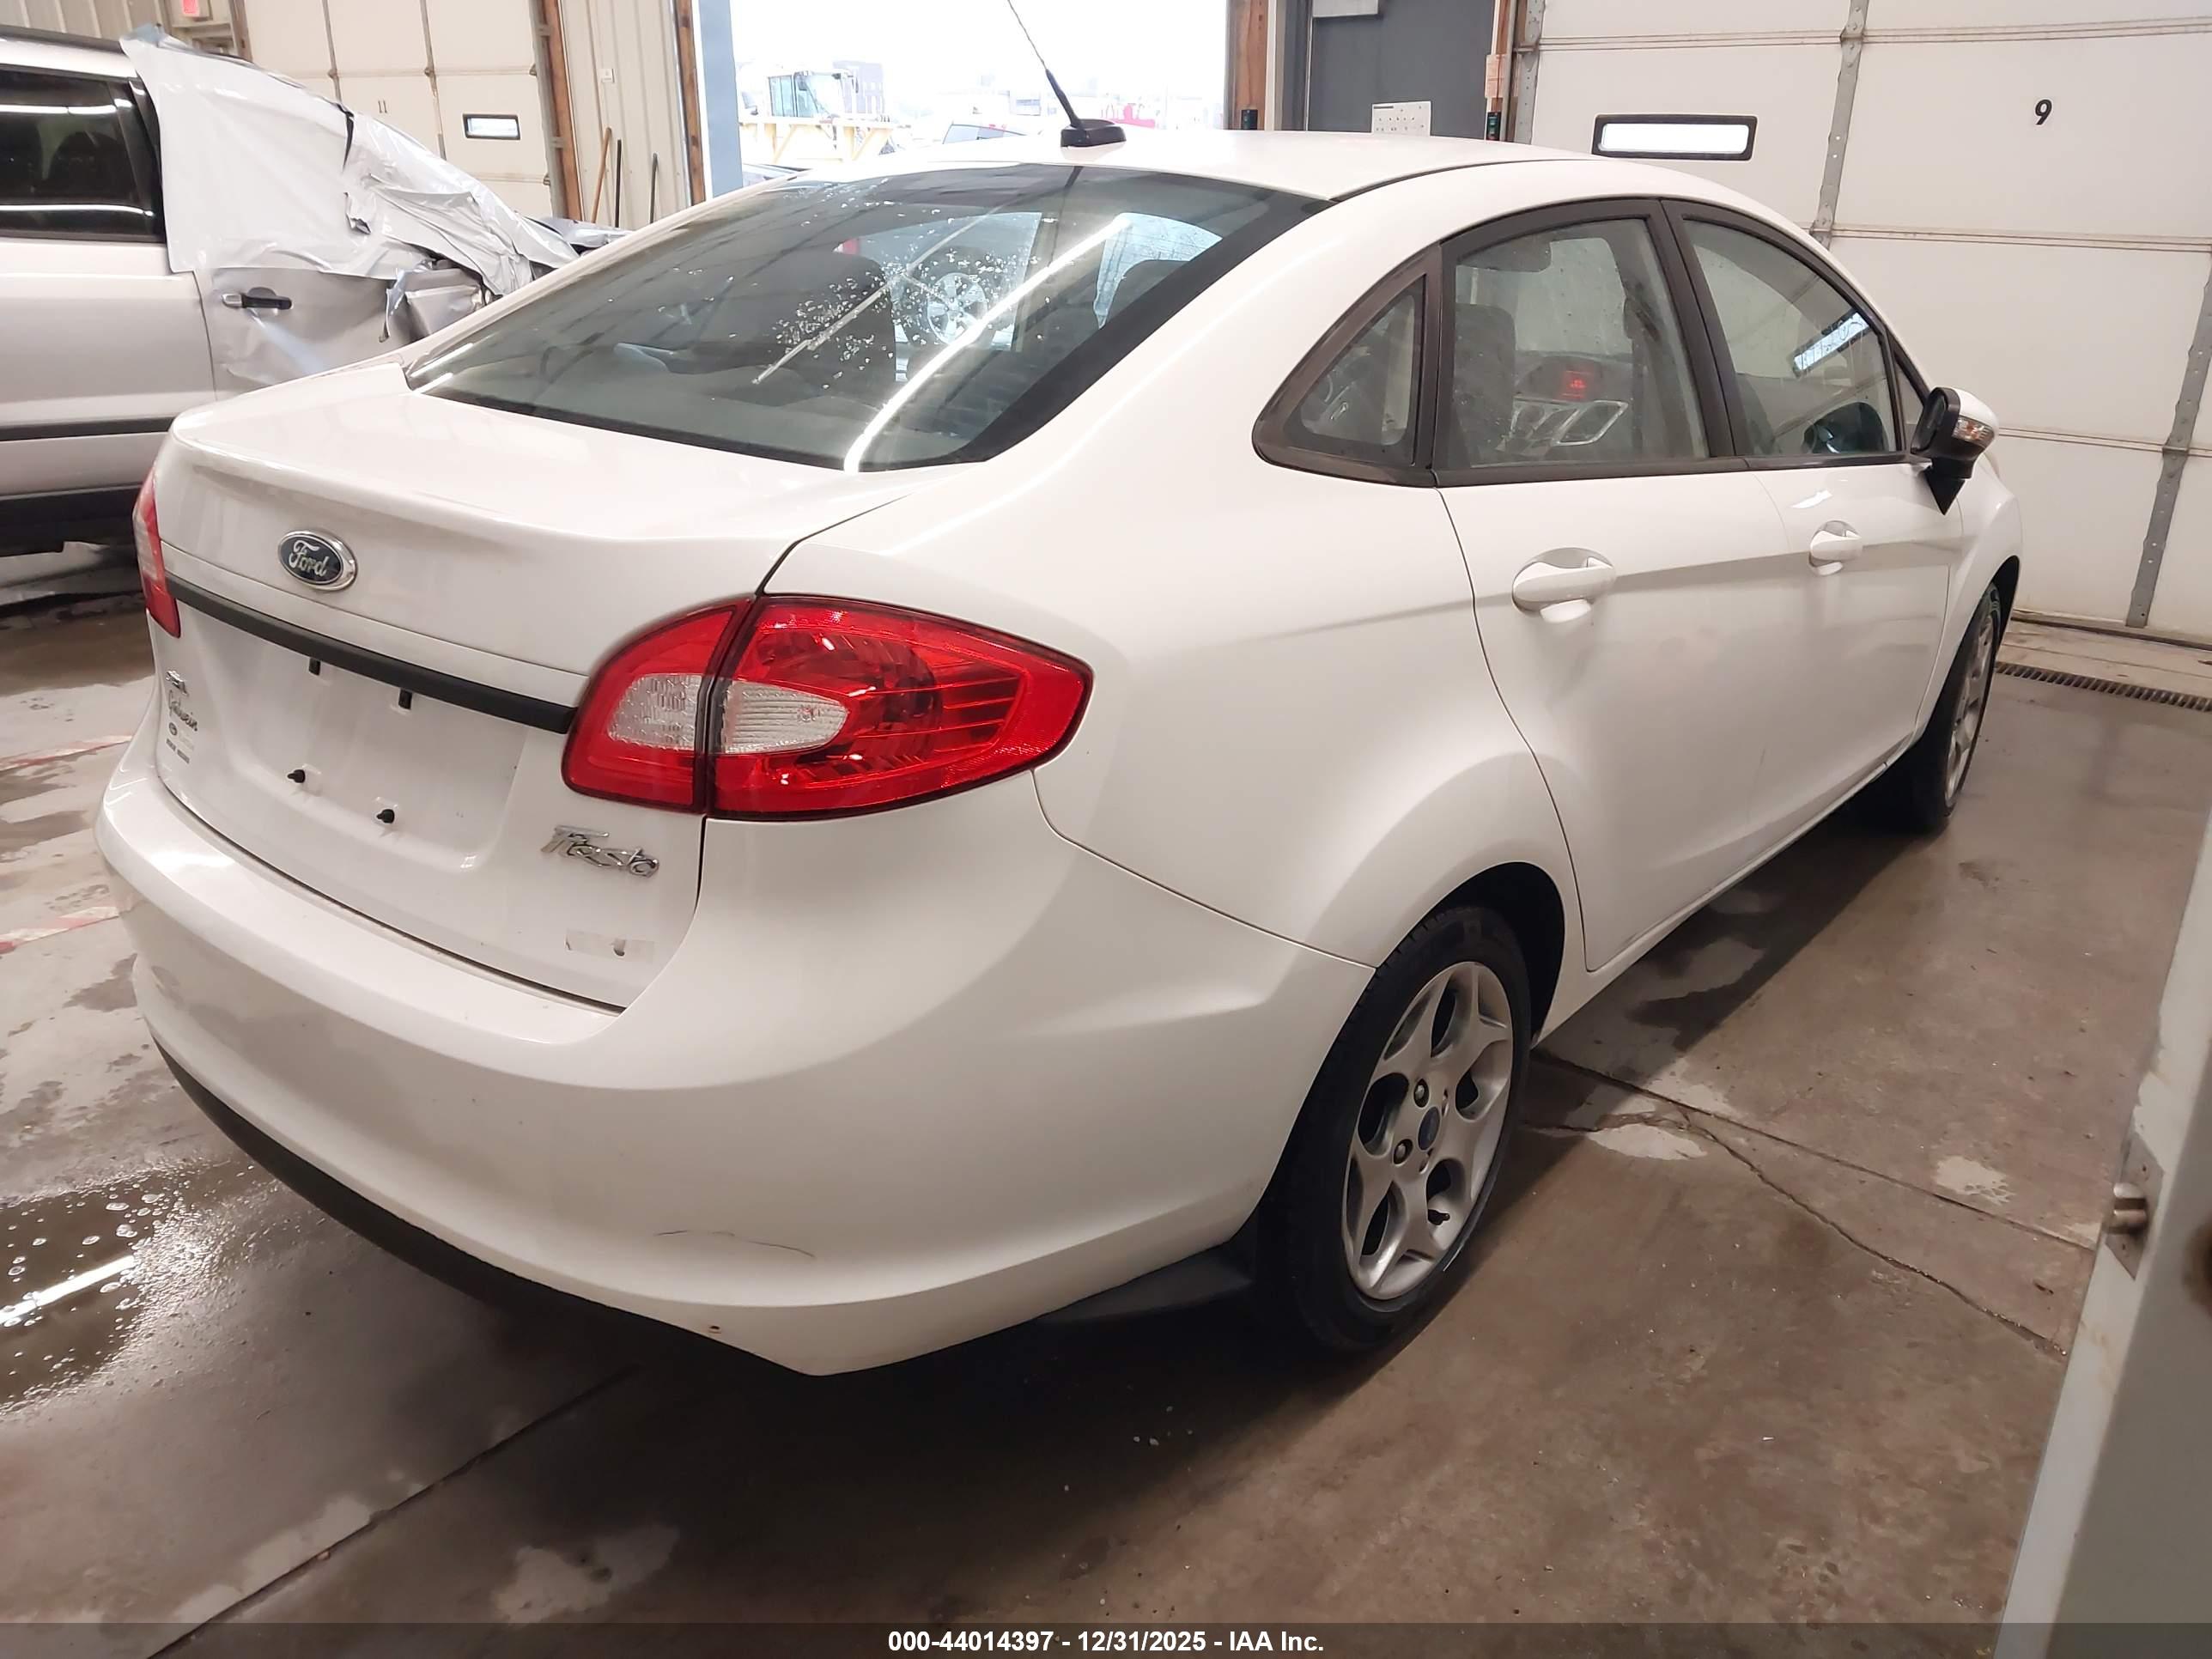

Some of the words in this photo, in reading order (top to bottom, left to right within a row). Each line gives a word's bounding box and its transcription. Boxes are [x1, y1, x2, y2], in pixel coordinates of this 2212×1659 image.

[2035, 99, 2052, 125] 9
[289, 539, 330, 576] Ford
[541, 825, 659, 878] Fiesta
